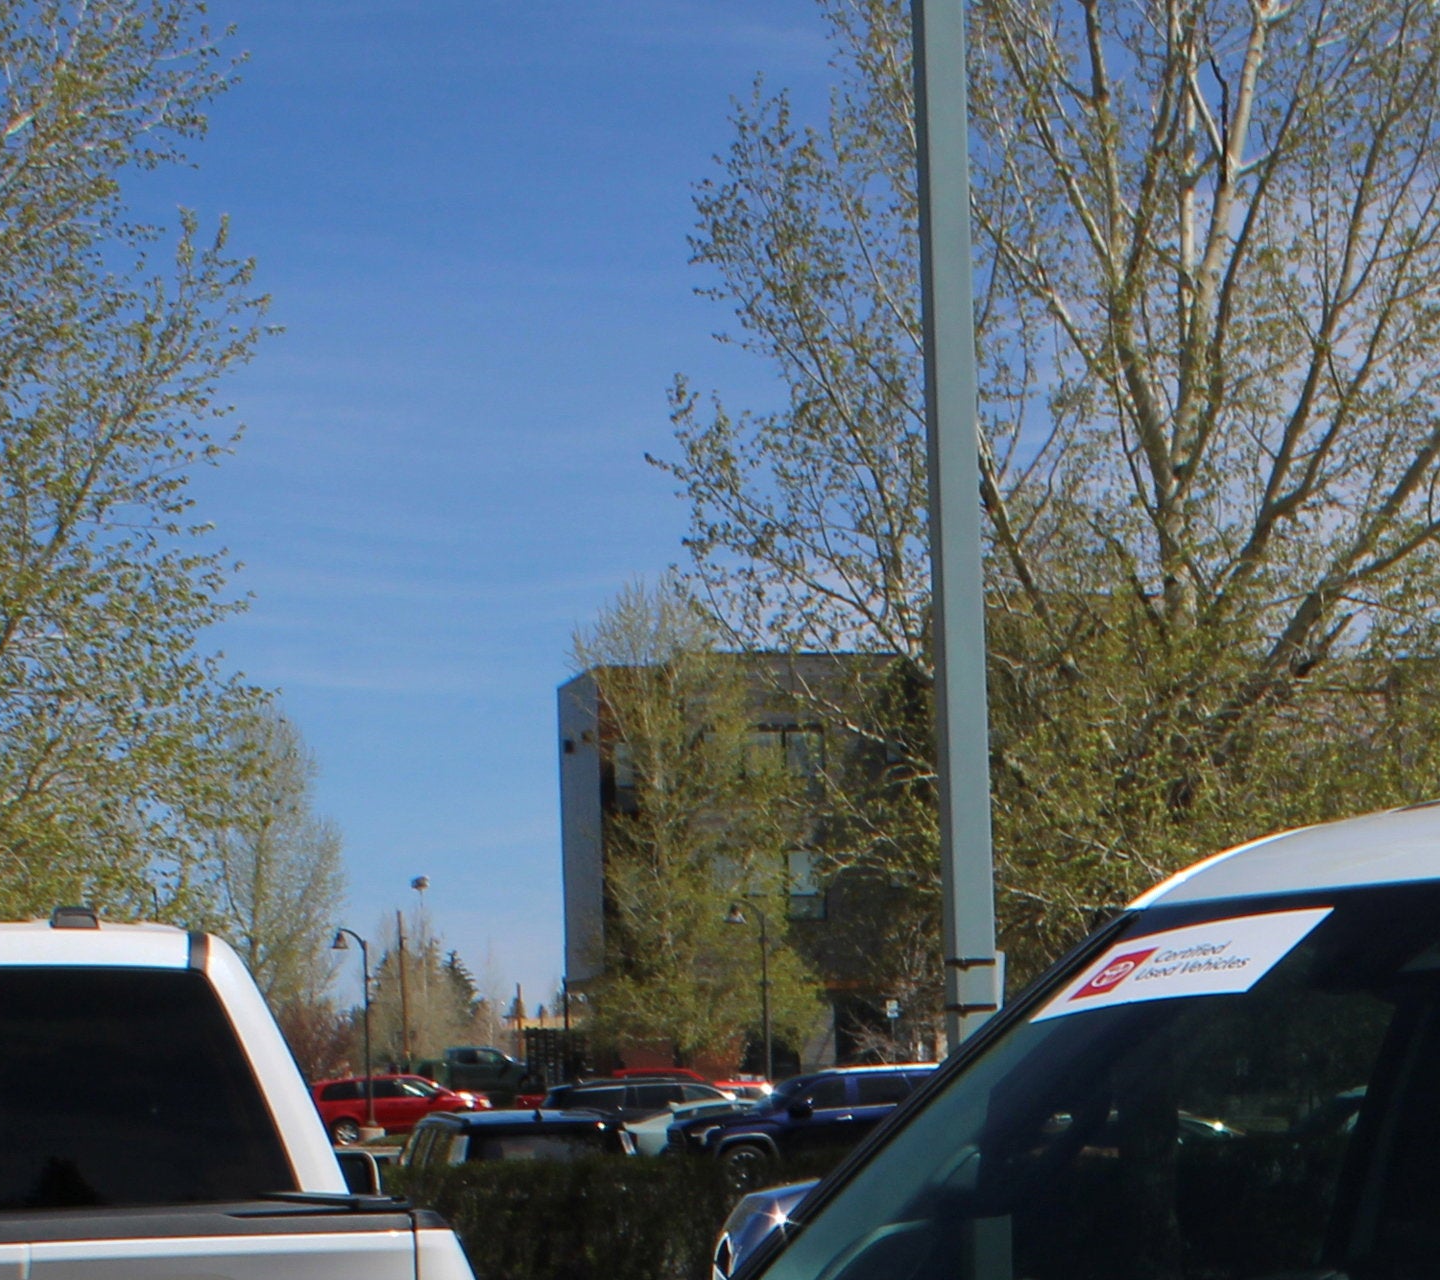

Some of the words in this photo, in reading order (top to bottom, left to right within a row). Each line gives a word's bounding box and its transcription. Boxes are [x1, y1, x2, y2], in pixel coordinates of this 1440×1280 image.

[1154, 940, 1233, 963] Certified
[1134, 960, 1181, 982] Used
[1179, 955, 1251, 975] Vehicles
